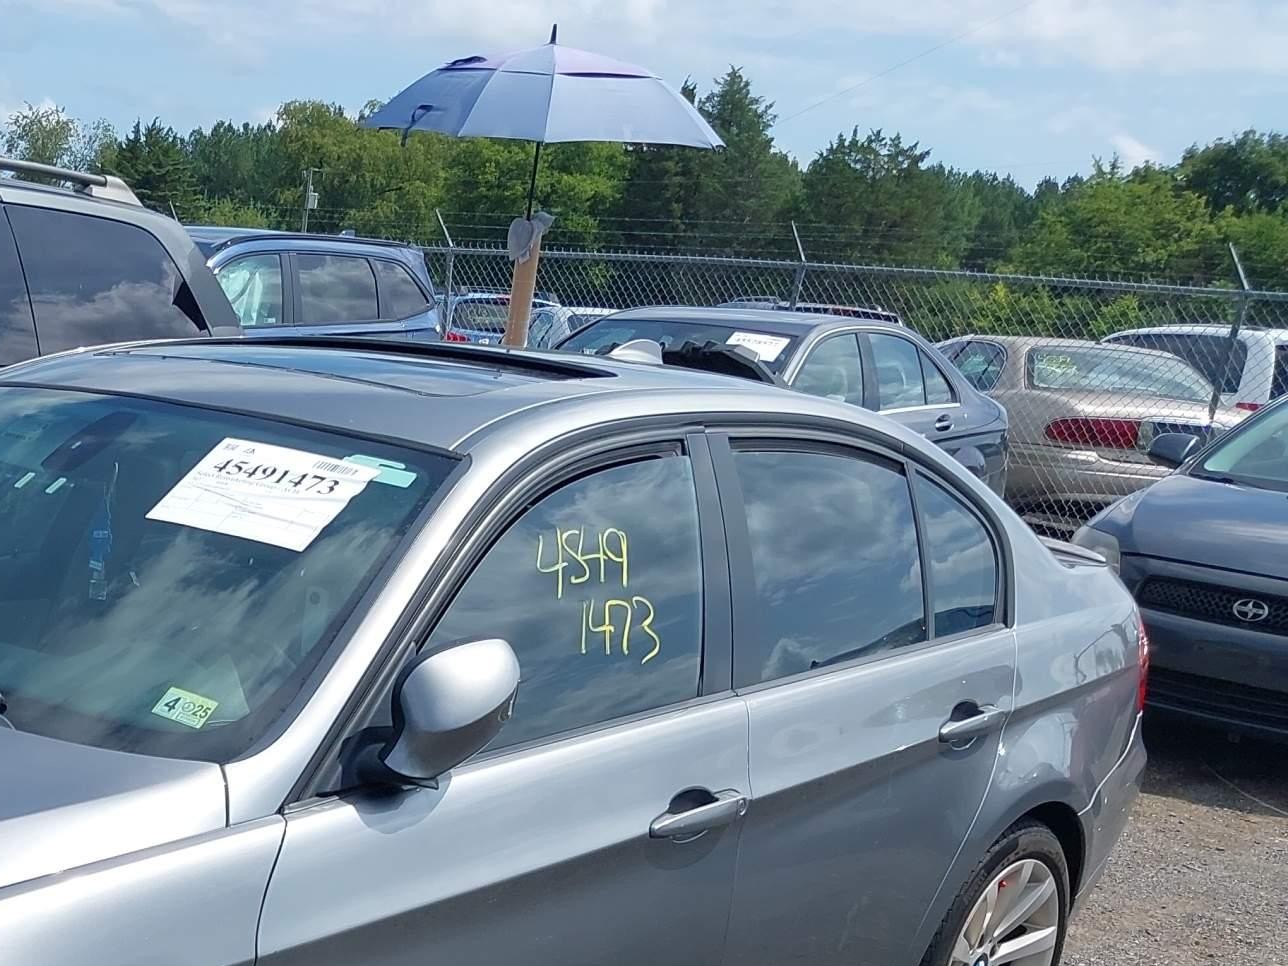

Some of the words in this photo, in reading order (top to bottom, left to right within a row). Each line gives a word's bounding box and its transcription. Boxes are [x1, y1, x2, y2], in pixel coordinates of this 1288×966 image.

[213, 458, 340, 495] 45491473
[536, 525, 628, 599] 4549
[580, 596, 660, 664] 1473
[164, 697, 182, 712] 4
[191, 704, 212, 719] 25
